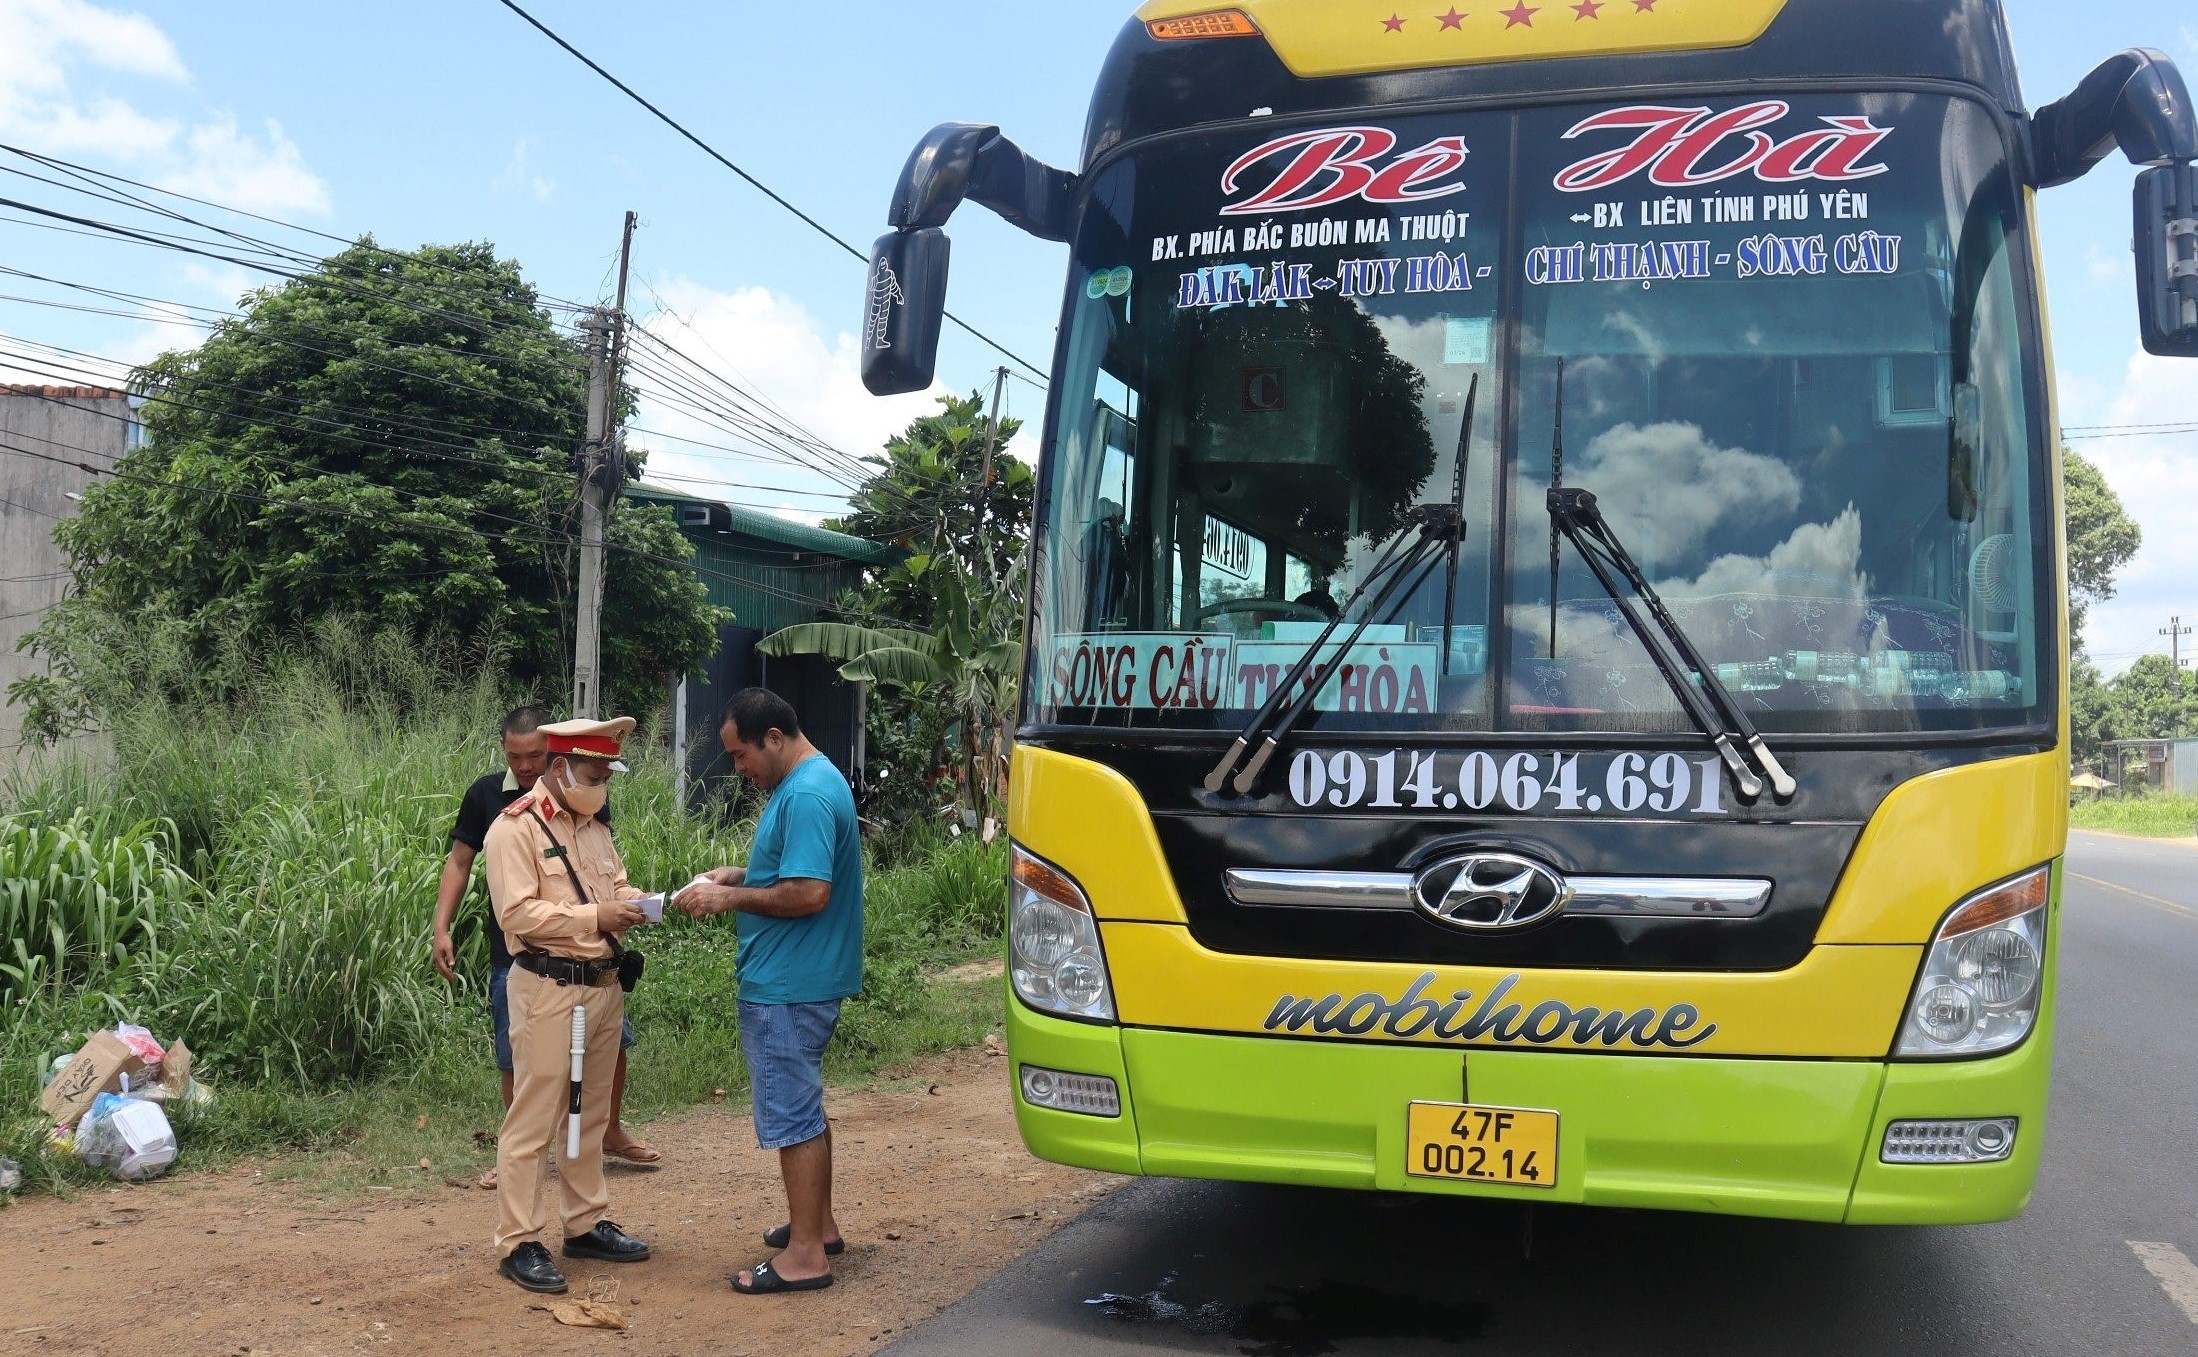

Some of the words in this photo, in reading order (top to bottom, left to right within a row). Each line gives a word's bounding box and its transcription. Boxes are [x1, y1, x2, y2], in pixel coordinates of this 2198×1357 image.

[1219, 126, 1470, 215] Bê
[1553, 100, 1895, 192] Hà
[1152, 235, 1184, 261] BX.
[1189, 225, 1235, 256] PHÍA
[1243, 218, 1284, 252] BẮC
[1290, 217, 1348, 248] BUÔN
[1354, 217, 1391, 243] MA
[1400, 208, 1470, 243] THUỘT
[1594, 202, 1624, 228] BX
[1641, 195, 1693, 226] LIÊN
[1763, 188, 1809, 221] PHÚ
[1819, 188, 1868, 219] YÊN
[1337, 257, 1402, 297] TUY
[1404, 250, 1473, 293] HÒA
[1525, 241, 1584, 285] CHÍ
[1590, 240, 1711, 291] THẠNH
[1737, 233, 1828, 279] SÔNG
[1833, 230, 1902, 274] CẦU
[1052, 639, 1137, 707] SÔNG
[1150, 637, 1227, 709] CẦU
[1339, 647, 1430, 714] HÒA
[1289, 750, 1728, 815] 0914.064.691
[1263, 971, 1718, 1049] mobihome
[1450, 1110, 1515, 1144] 47F
[1423, 1143, 1540, 1182] 002.14
